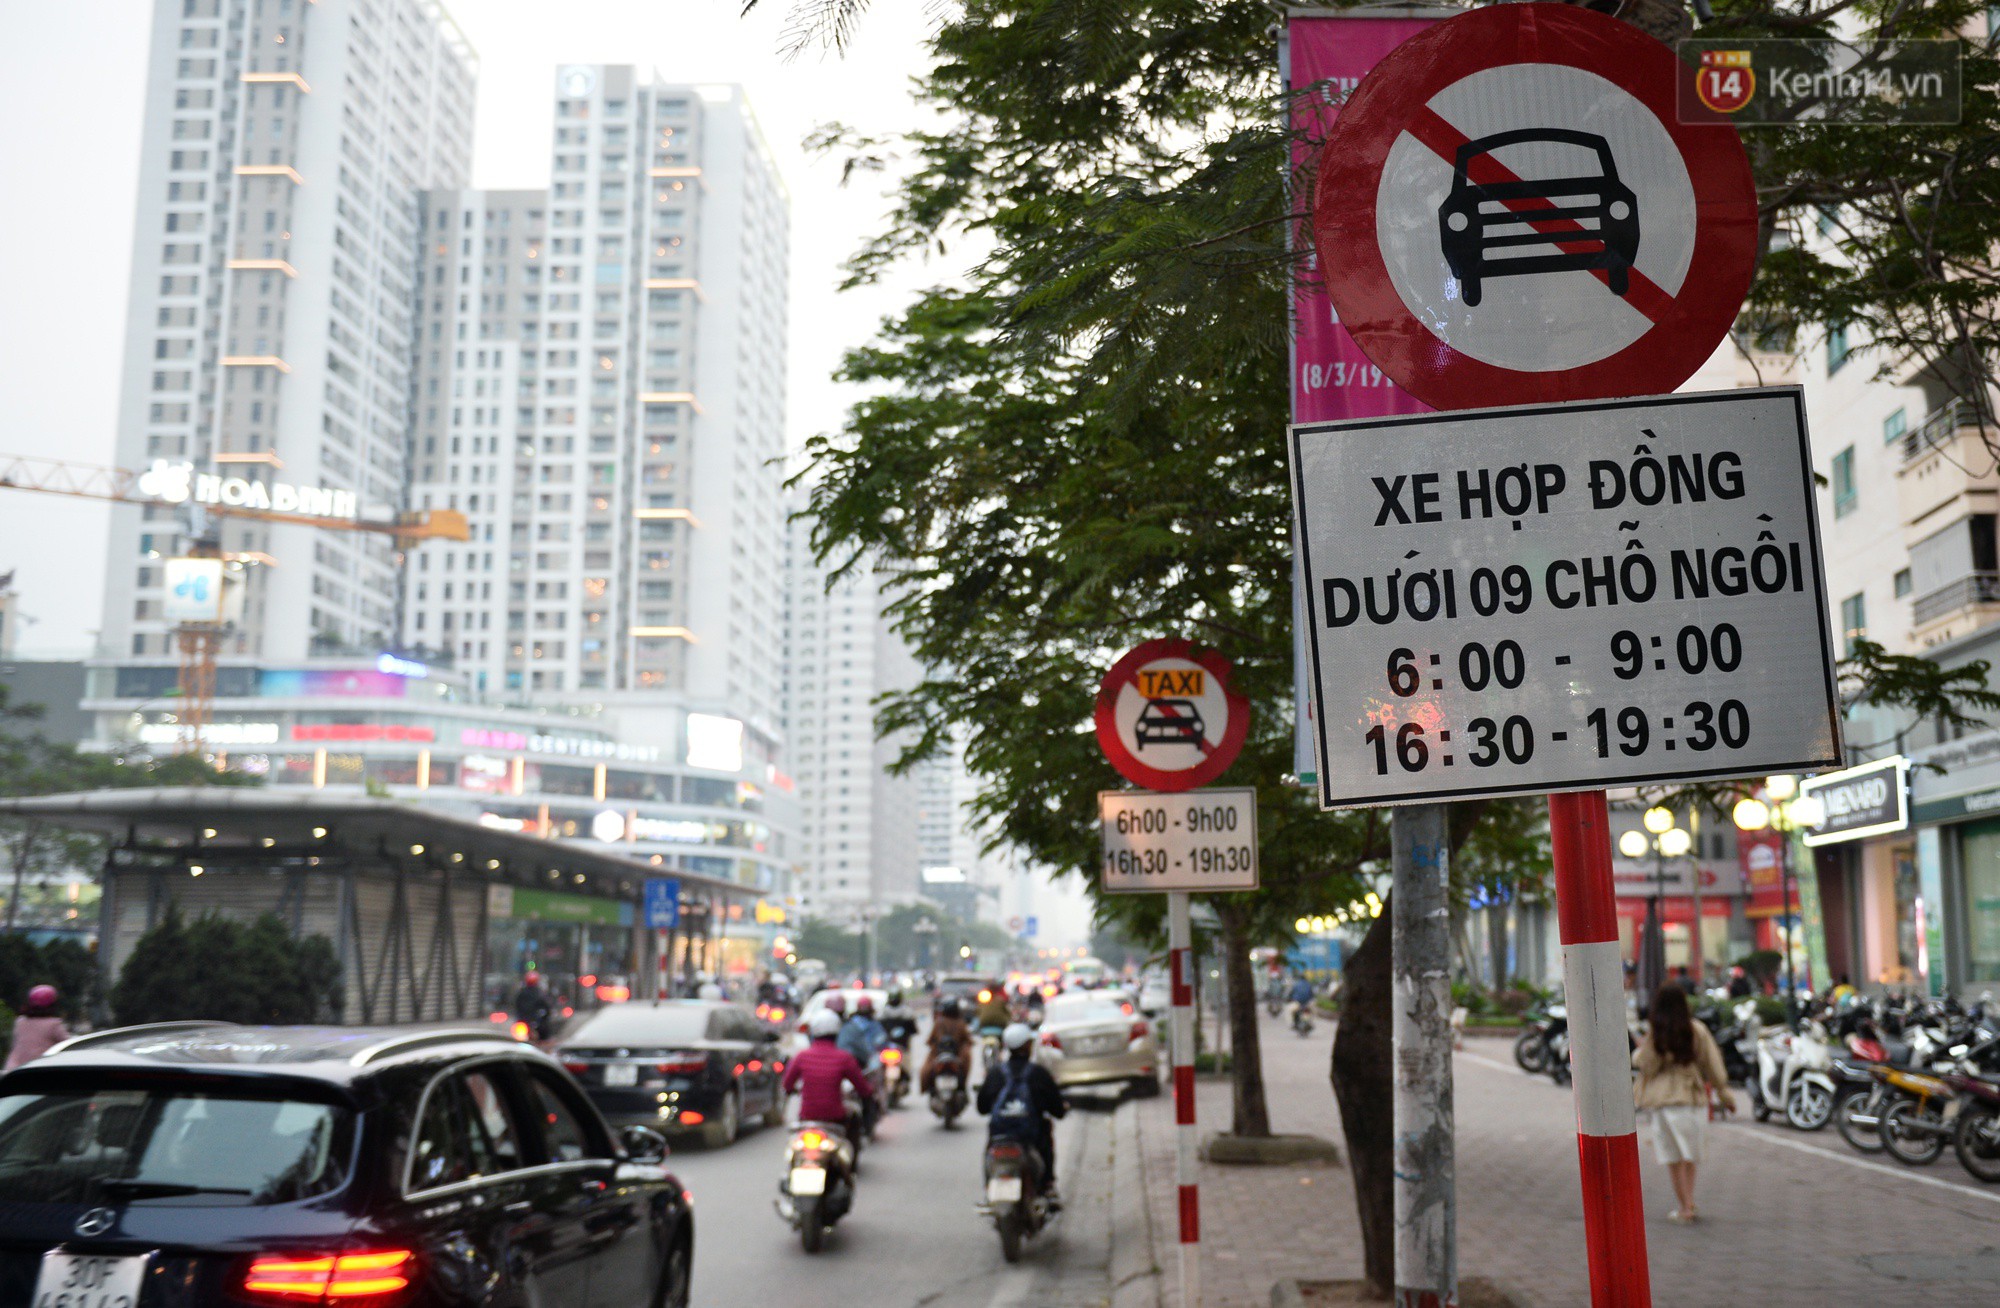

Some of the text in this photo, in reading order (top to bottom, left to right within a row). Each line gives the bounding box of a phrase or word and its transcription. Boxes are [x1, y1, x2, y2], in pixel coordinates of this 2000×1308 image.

[1371, 428, 1746, 532] XE HỢP ĐỒNG
[1322, 512, 1805, 629] DƯỚI 09 CHỖ NGỒI
[1610, 622, 1743, 681] 9:00
[1142, 671, 1201, 695] TAXI
[1365, 714, 1535, 776] 16:30
[1586, 698, 1751, 759] 19:30
[1117, 808, 1167, 835] 6h00
[1187, 805, 1237, 832] 9h00
[1107, 848, 1167, 876] 16h30
[1189, 845, 1251, 873] 19h30
